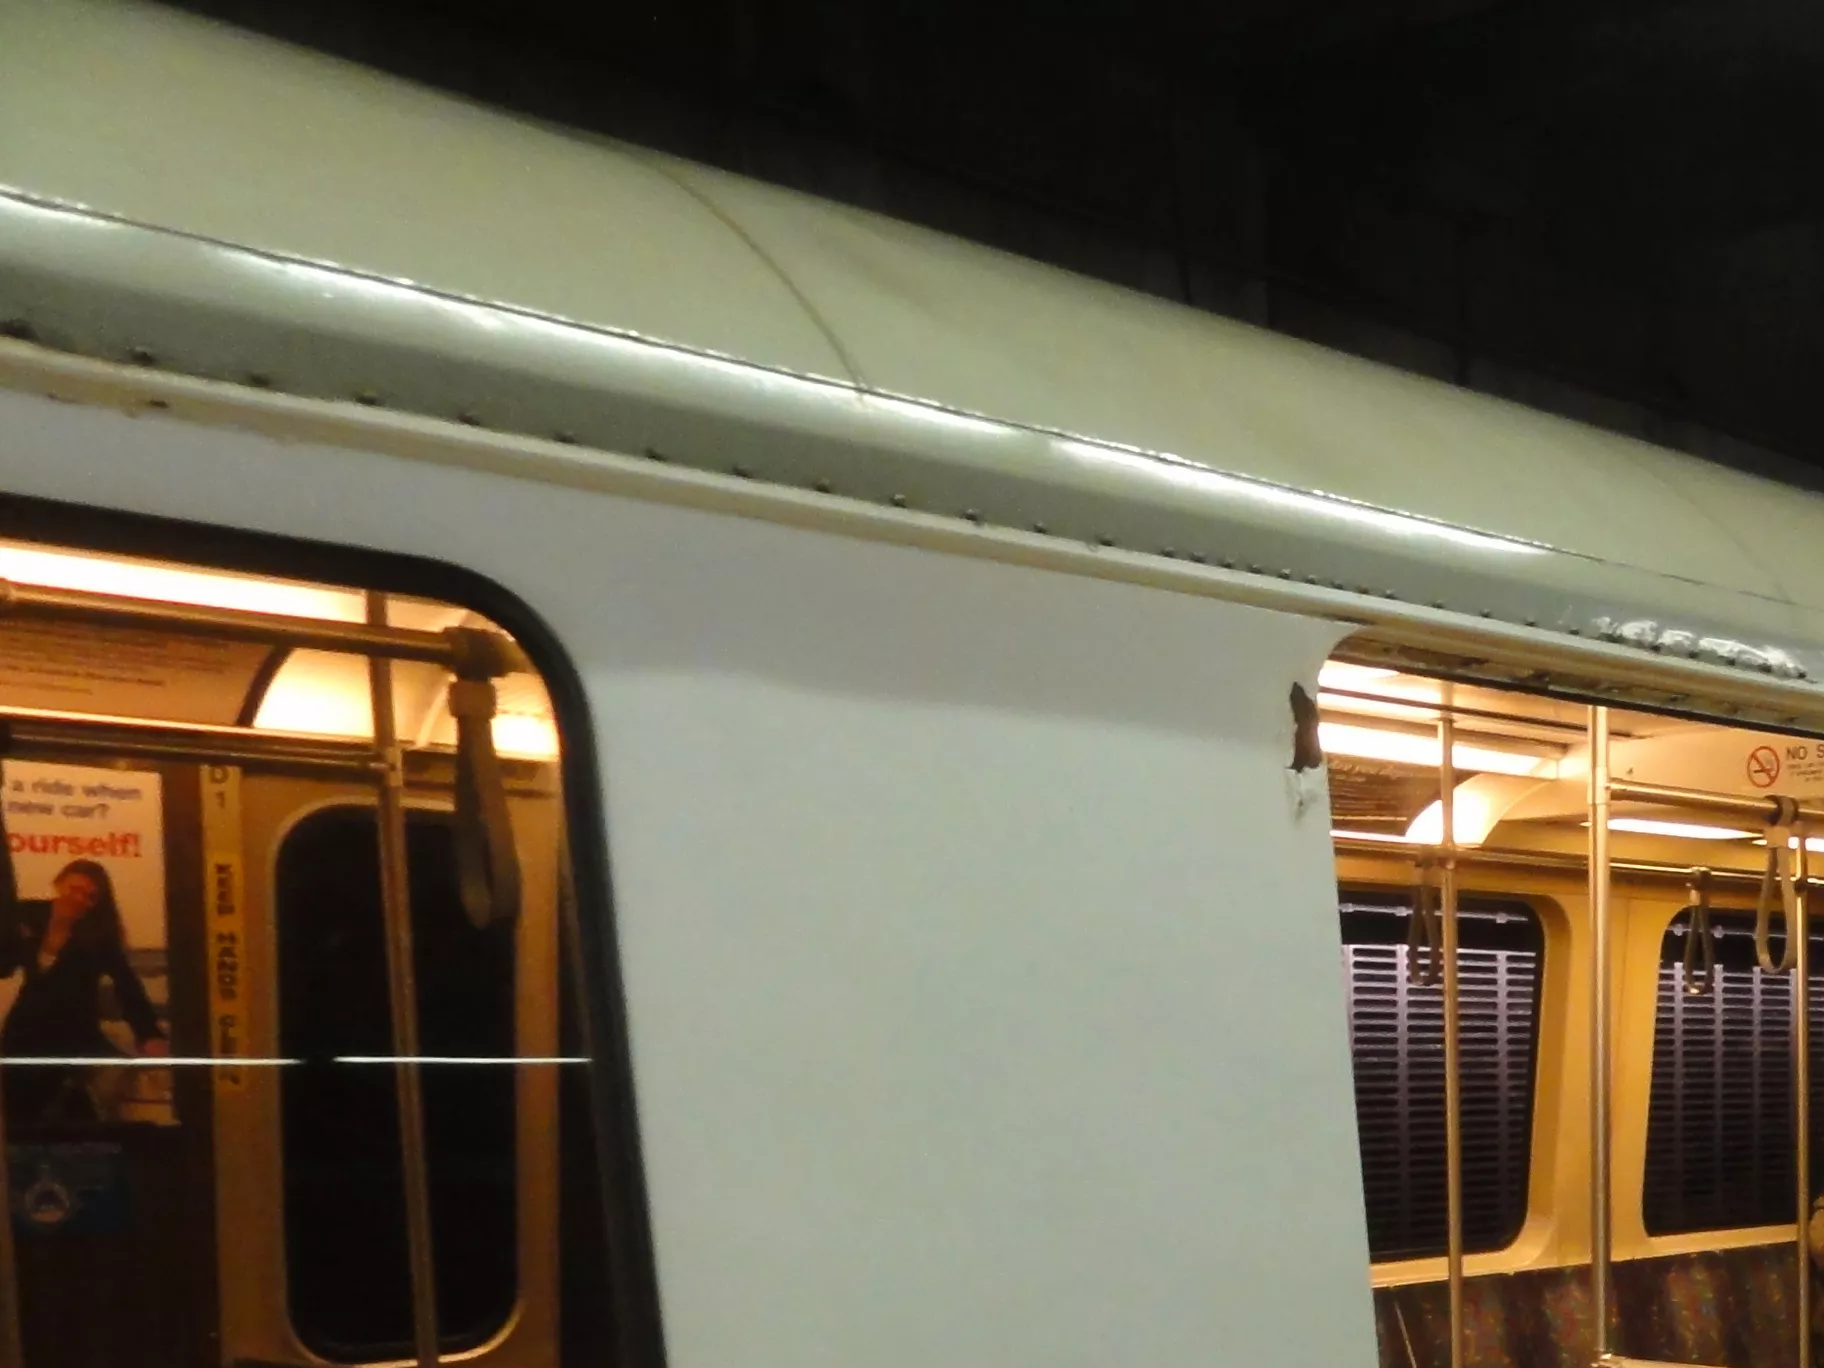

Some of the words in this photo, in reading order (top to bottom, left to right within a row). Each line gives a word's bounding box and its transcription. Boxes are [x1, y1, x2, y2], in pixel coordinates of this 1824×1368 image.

[1785, 746, 1808, 760] NO
[31, 778, 73, 796] ride
[82, 784, 142, 801] when
[61, 803, 110, 819] car?
